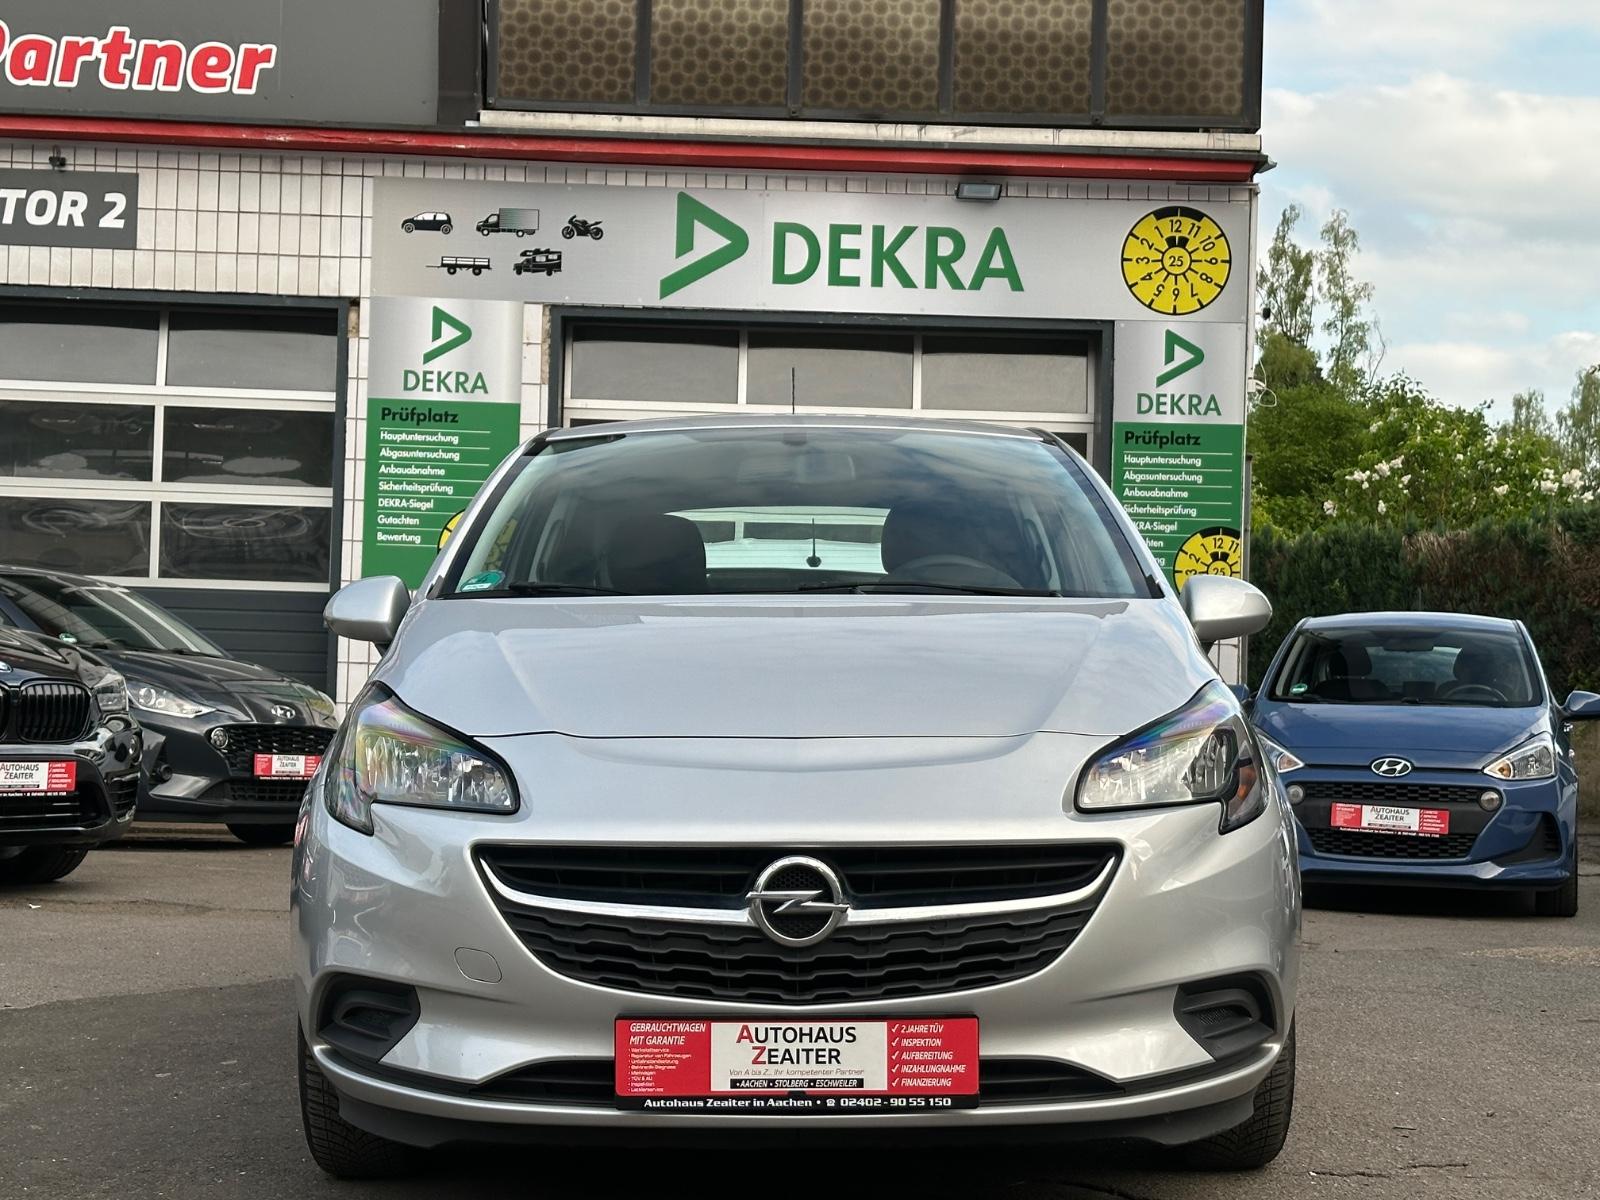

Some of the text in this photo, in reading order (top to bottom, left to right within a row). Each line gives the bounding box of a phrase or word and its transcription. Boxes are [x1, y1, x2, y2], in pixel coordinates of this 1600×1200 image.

[0, 188, 127, 229] TOR 2
[1154, 225, 1164, 238] 1
[1169, 219, 1182, 233] 12
[1188, 222, 1201, 238] 11
[1140, 238, 1154, 250] 2
[1199, 235, 1216, 252] 10
[772, 222, 1024, 292] DEKRA
[1136, 256, 1150, 265] 3
[1169, 255, 1183, 267] 25
[1204, 257, 1218, 265] 9
[1140, 272, 1153, 281] 4
[1199, 272, 1214, 284] 8
[1153, 284, 1165, 297] 5
[1172, 287, 1180, 302] 6
[1190, 283, 1198, 298] 7
[403, 369, 489, 394] DEKRA
[1136, 392, 1222, 416] DEKRA
[381, 407, 459, 426] Prüfplatz
[380, 431, 459, 445] Hauptuntersuchung
[1124, 430, 1201, 449] Prüfplatz
[379, 447, 460, 461] Abgasuntersuchung
[1124, 454, 1202, 467] Hauptuntersuchung
[379, 464, 445, 476] Anbauabnahme
[1123, 470, 1203, 484] Abgasuntersuchung
[378, 481, 454, 494] Sicherheitsprüfung
[1123, 487, 1189, 498] Anbauabnahme
[378, 498, 434, 510] DEKRA-Siegel
[1123, 503, 1197, 517] Sicherheitsprüfung
[377, 514, 419, 525] Gutachten
[1134, 521, 1178, 533] KRA-Siegel
[377, 532, 421, 544] Bewertung
[1213, 538, 1224, 549] 12
[1200, 543, 1209, 553] 1
[1229, 540, 1239, 553] 11
[1189, 553, 1201, 563] 2
[1212, 567, 1226, 576] 25
[0, 763, 39, 771] AUTOHAUS
[1370, 806, 1410, 815] AUTOHAUS
[1375, 814, 1405, 822] ZEAITER
[630, 1022, 706, 1032] GEBRAUCHTWAGEN
[929, 1023, 944, 1033] TÜV
[736, 1024, 857, 1043] AUTOHAUS
[629, 1036, 686, 1045] MIT GARANTIE
[901, 1038, 942, 1047] INSPEKTION
[751, 1045, 841, 1065] ZEAITER
[901, 1051, 953, 1060] AUFBEREITUNG
[786, 1068, 834, 1077] kompetenter
[901, 1064, 967, 1073] INZAHLUNGNAHME
[774, 1079, 809, 1087] STOLBERG
[816, 1079, 858, 1087] ESCHWEILER
[901, 1078, 952, 1087] FINANZIERUNG
[644, 1099, 704, 1107] Autohaus
[706, 1099, 751, 1107] Zeaiter
[753, 1098, 764, 1107] in
[766, 1098, 812, 1107] Aachen
[909, 1098, 925, 1107] 55
[928, 1098, 952, 1107] 150
